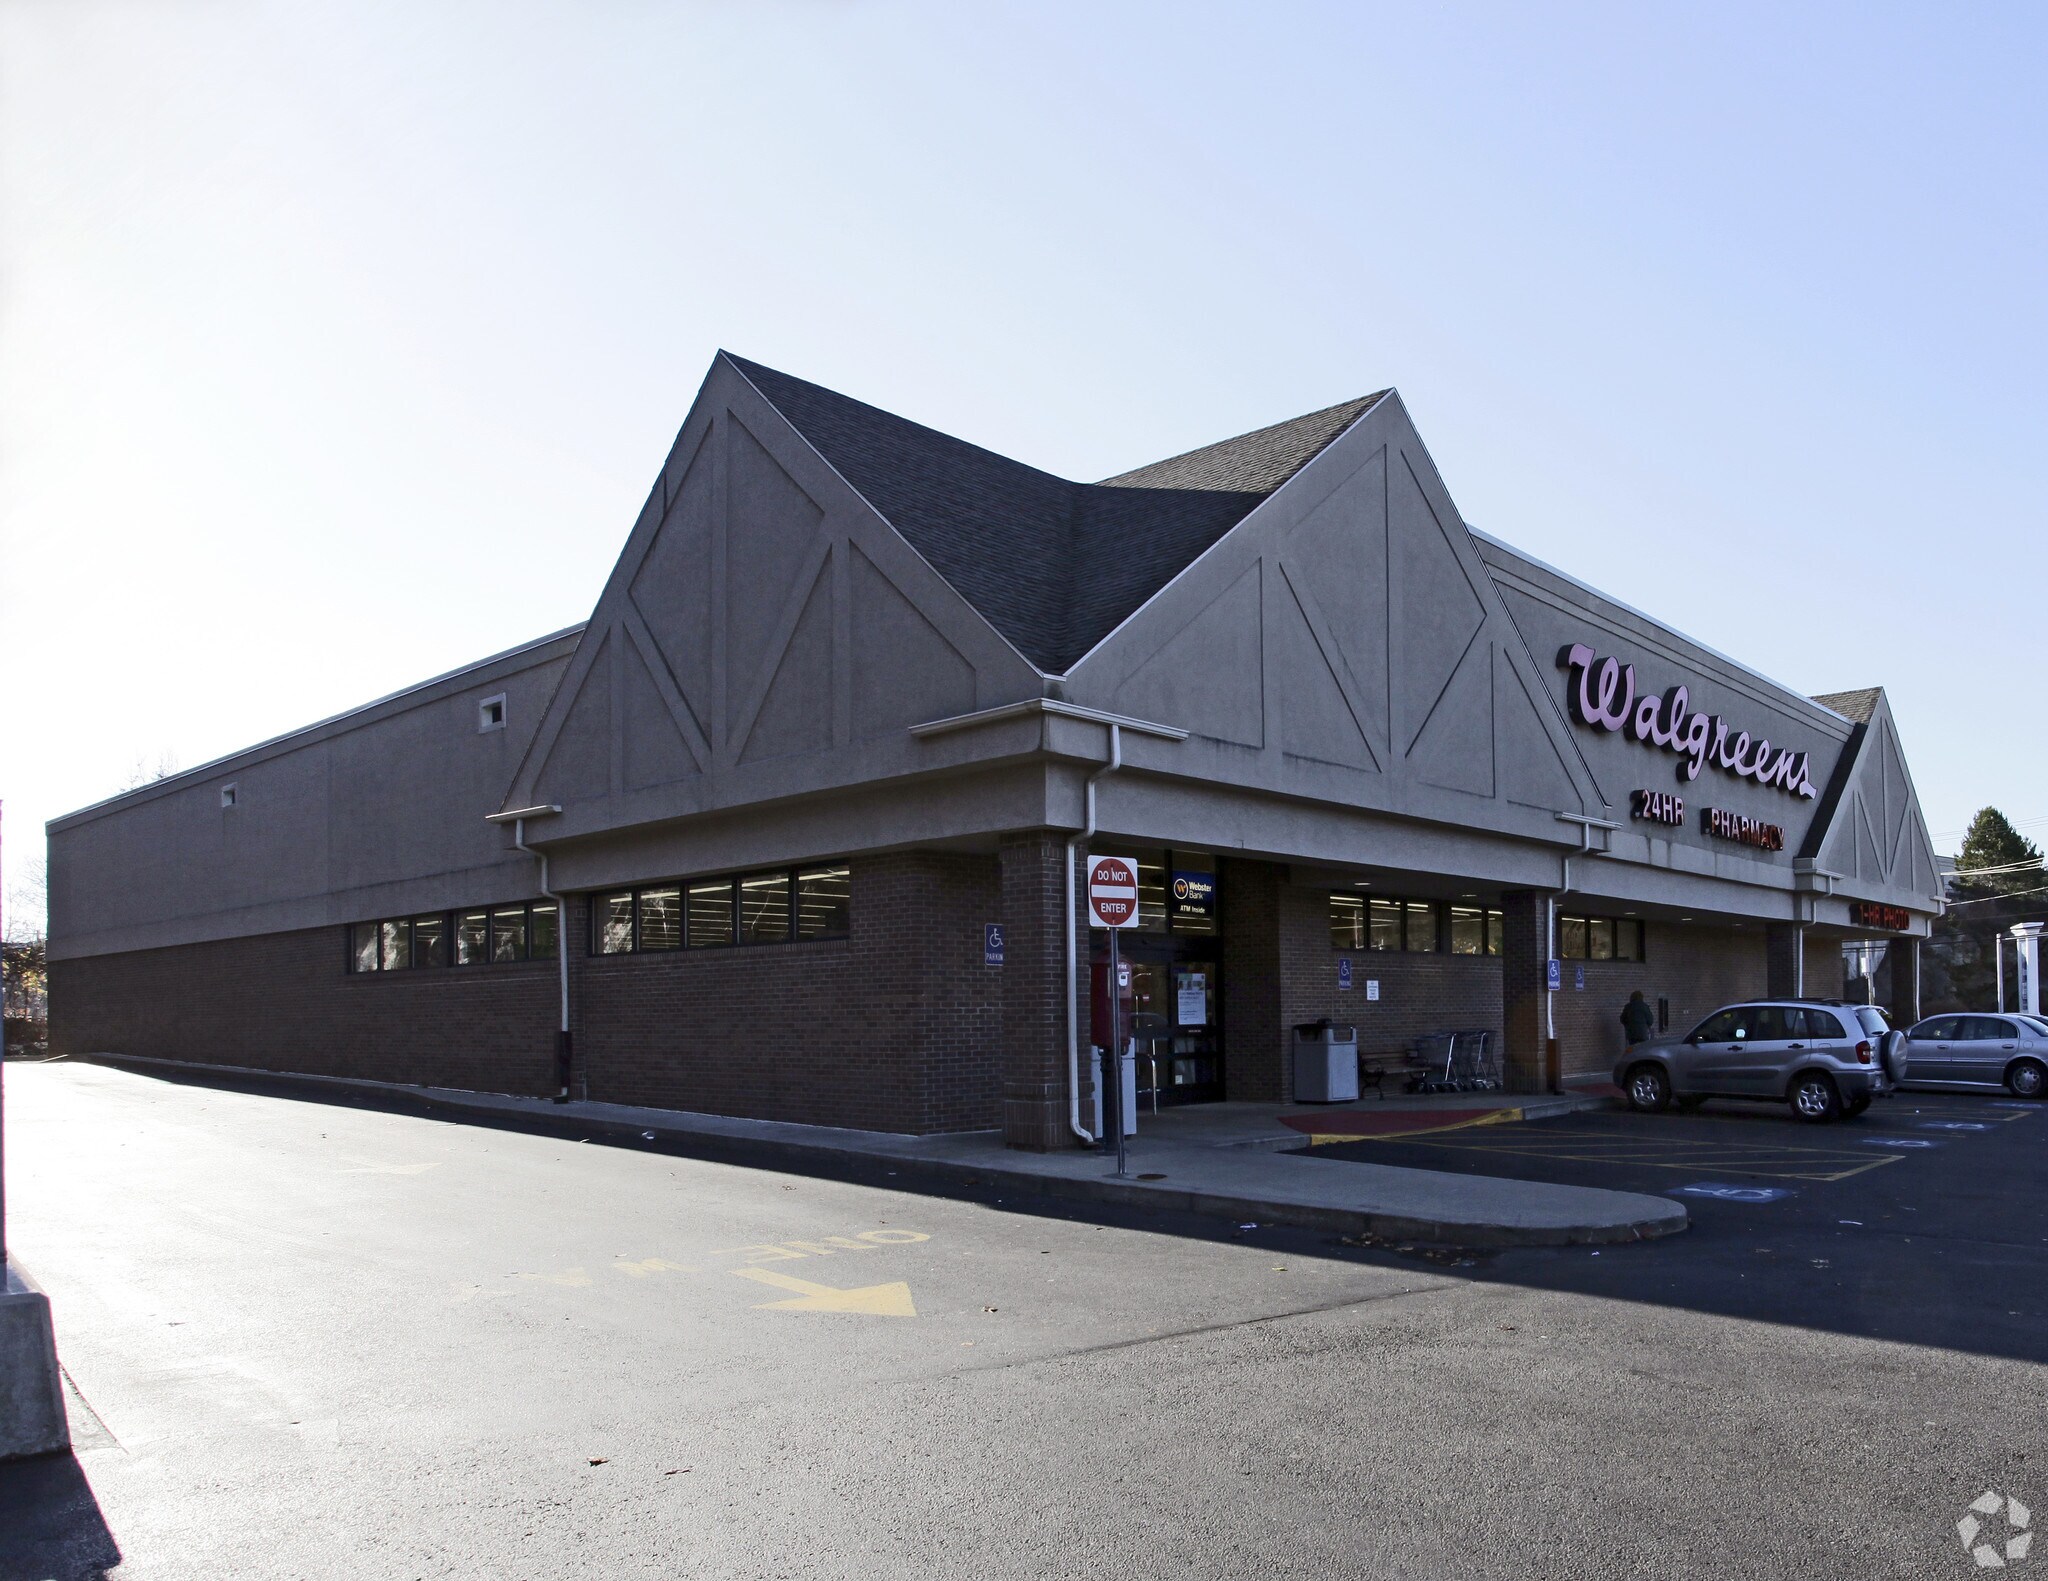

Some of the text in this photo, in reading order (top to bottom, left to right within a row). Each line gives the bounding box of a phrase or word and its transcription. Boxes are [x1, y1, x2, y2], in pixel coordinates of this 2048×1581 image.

[1567, 643, 1818, 800] Walgreens
[1642, 789, 1785, 851] 24HR PHARMACY
[1097, 870, 1127, 882] DO NOT
[1189, 881, 1212, 892] Webster
[1189, 890, 1204, 900] Bank
[1100, 902, 1127, 913] ENTER
[1180, 904, 1206, 914] ATM Inside
[1859, 904, 1910, 930] 1-HR PHOTO
[986, 953, 1004, 961] PARKIN
[709, 1230, 932, 1265] ONE
